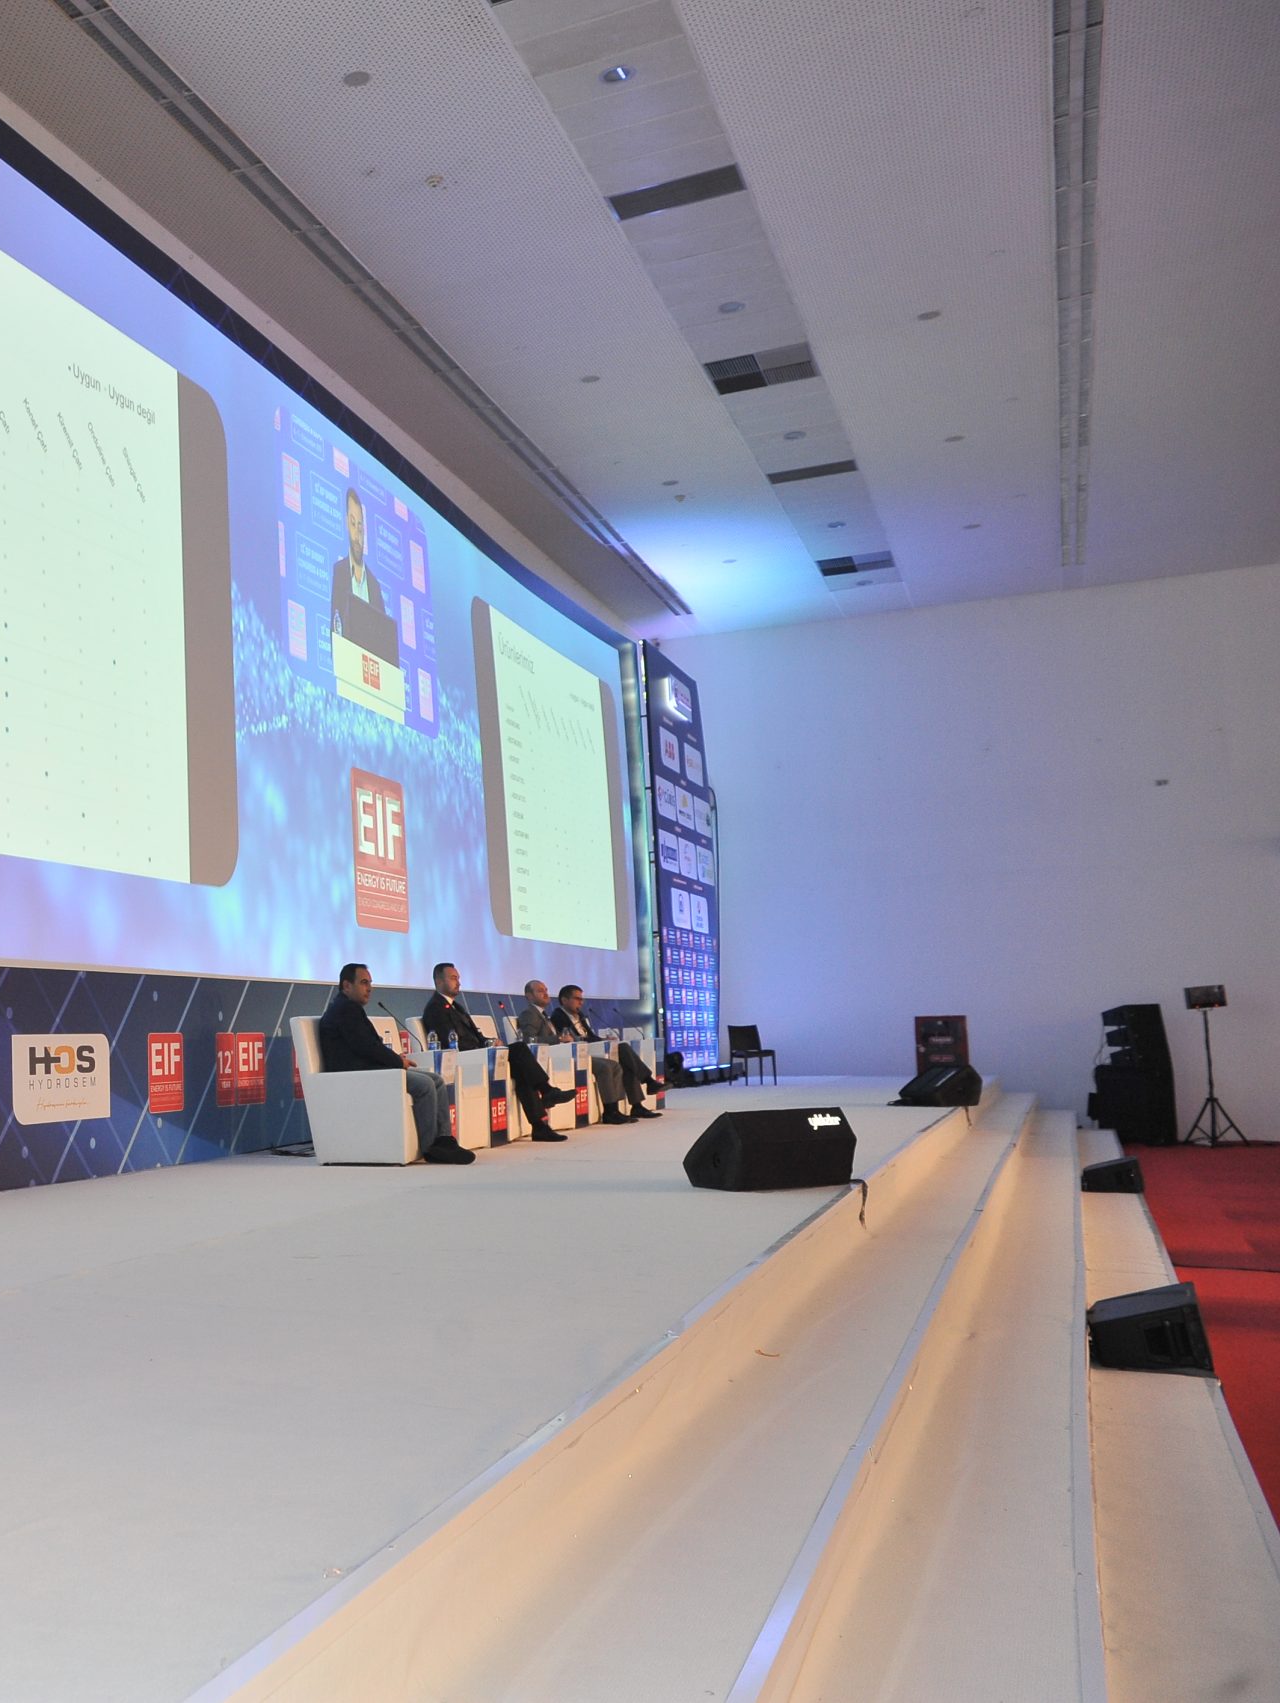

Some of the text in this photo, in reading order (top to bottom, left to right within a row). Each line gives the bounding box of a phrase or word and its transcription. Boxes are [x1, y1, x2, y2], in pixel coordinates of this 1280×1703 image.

[72, 362, 156, 425] Uygun Uygun değil
[356, 787, 402, 861] EIF
[357, 871, 407, 895] ENERGY IS FUTURE
[151, 1042, 181, 1076] EIF
[238, 1041, 263, 1072] EIF
[28, 1076, 97, 1091] HYDROSEM
